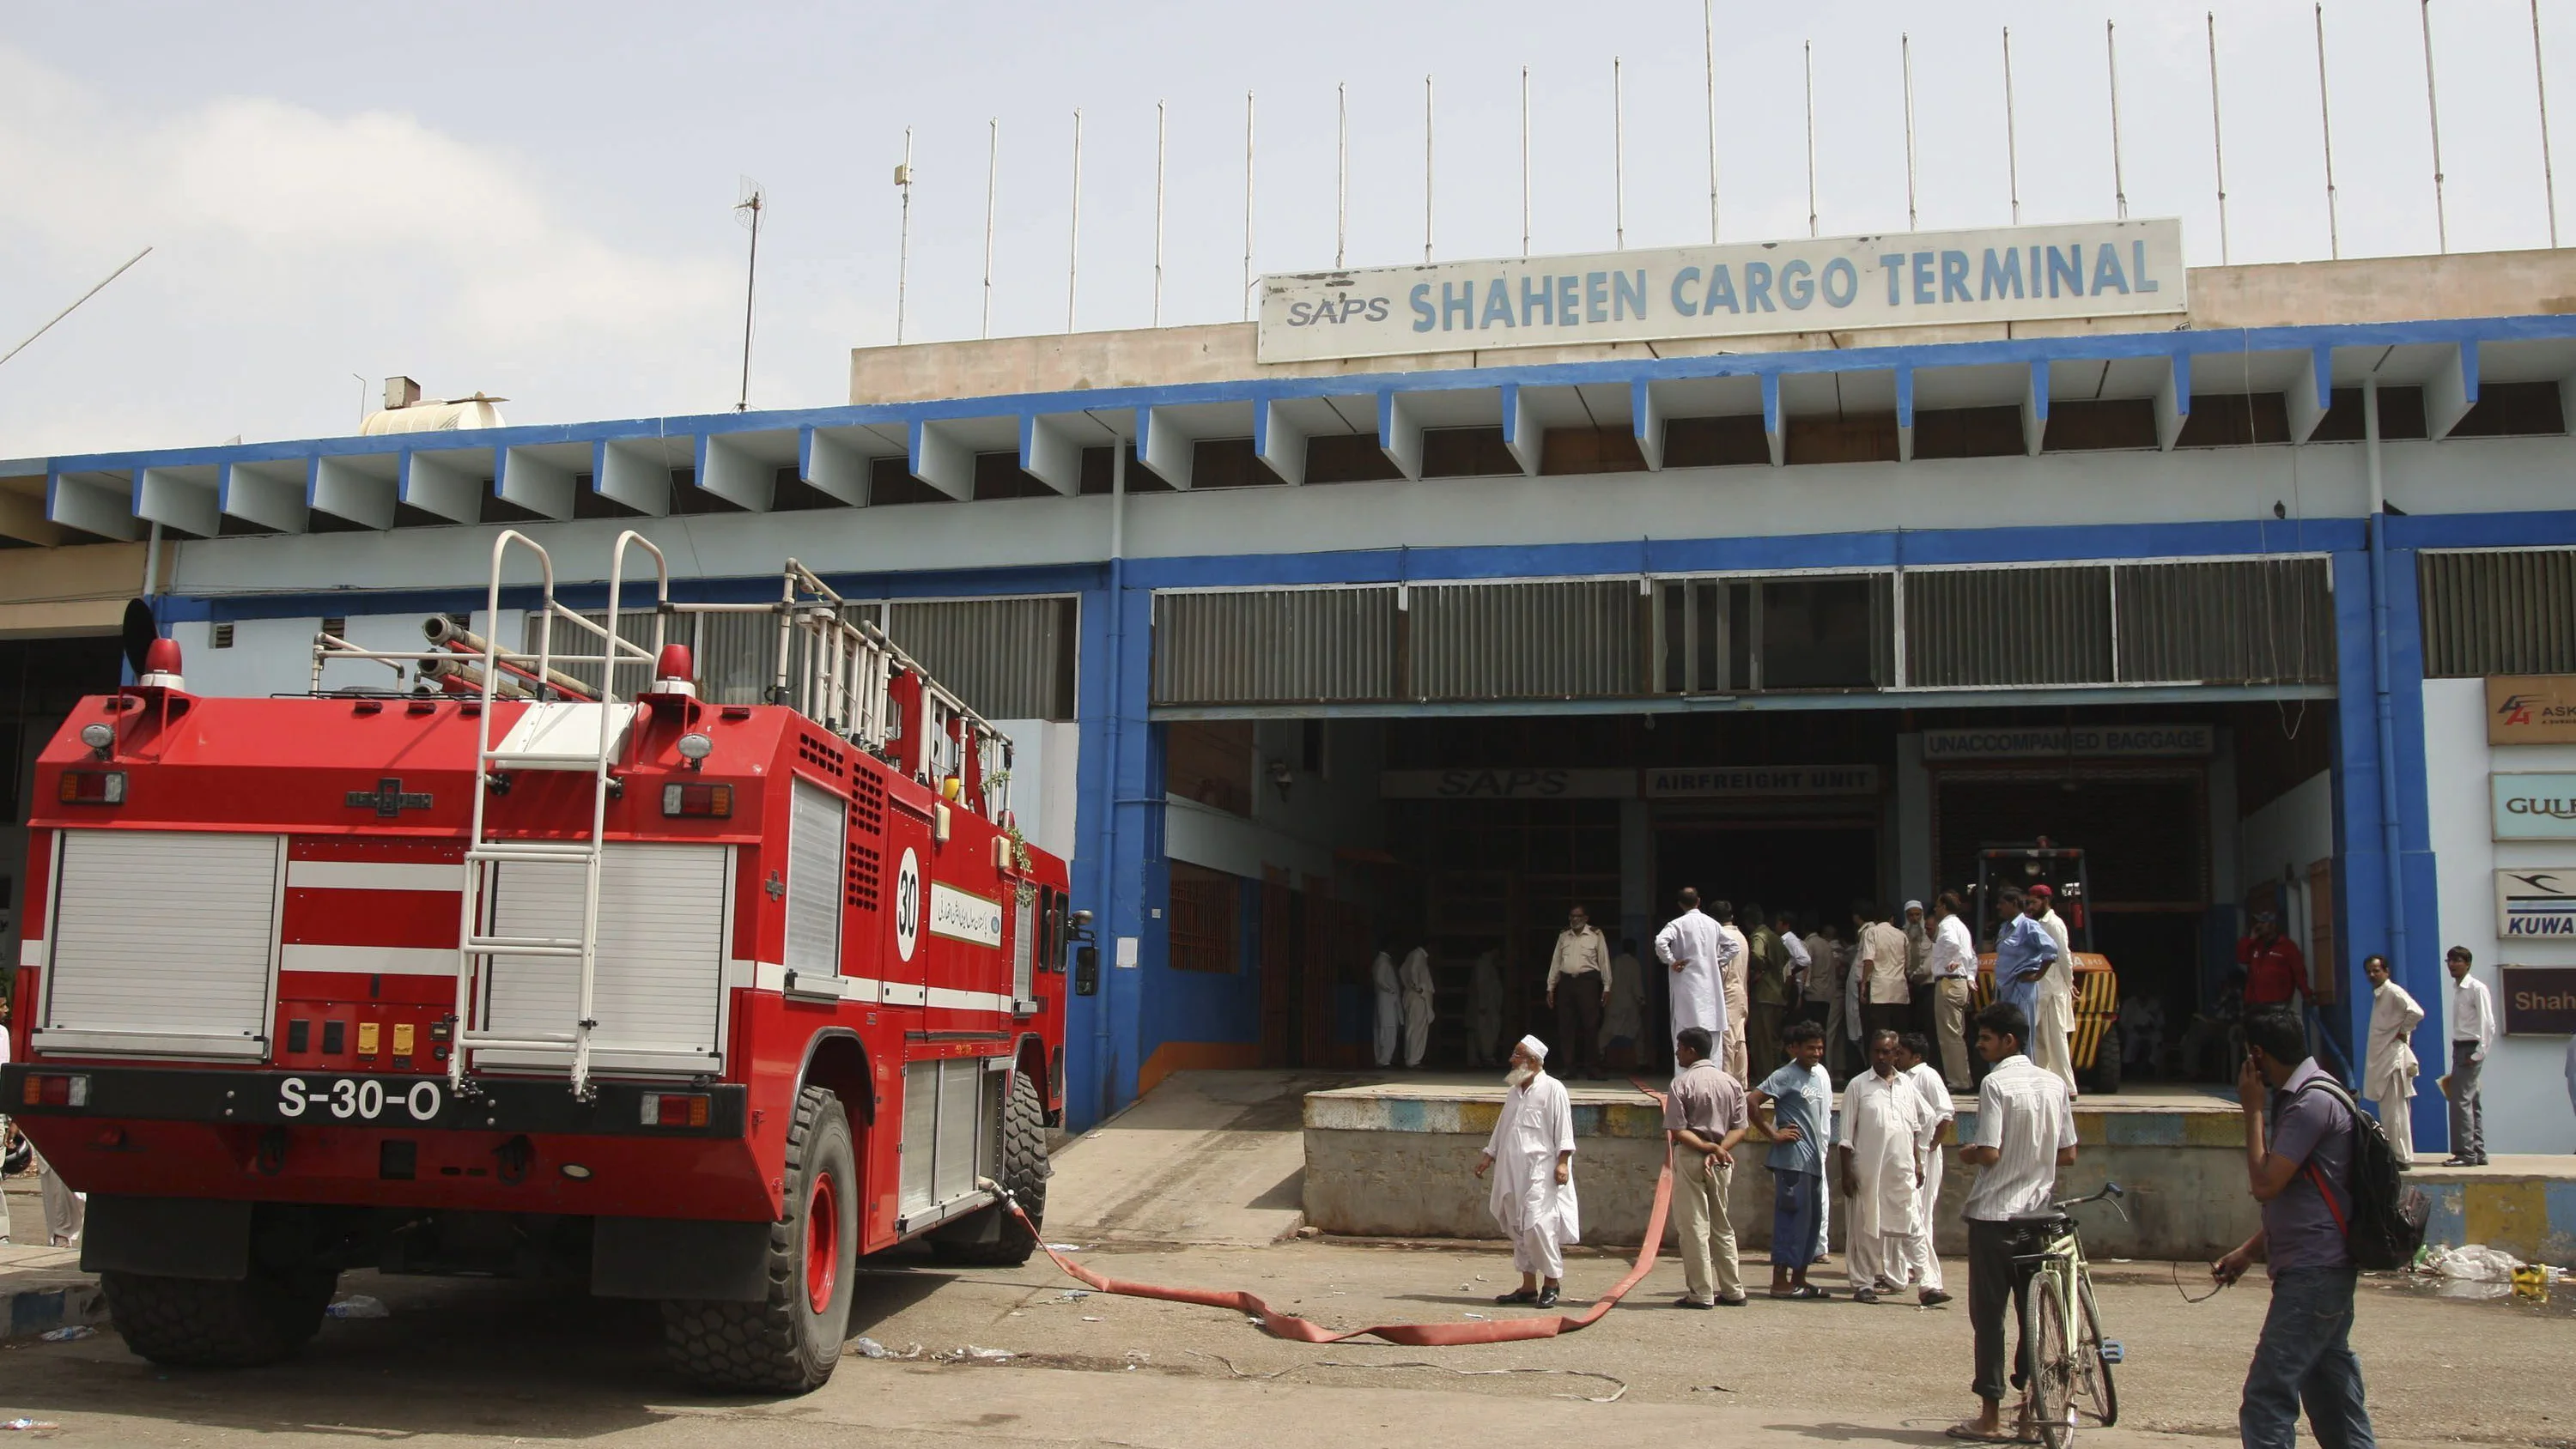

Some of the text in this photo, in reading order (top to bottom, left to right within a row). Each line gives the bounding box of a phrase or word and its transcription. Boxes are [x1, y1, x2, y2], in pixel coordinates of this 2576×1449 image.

[1286, 239, 2159, 333] SAPS SHAHEEN CARGO TERMINAL
[2106, 730, 2206, 750] BAGGAGE
[1437, 768, 1570, 796] SAPS
[1656, 771, 1868, 791] AIRFREIGHT UNIT
[899, 870, 916, 938] 30
[2515, 991, 2576, 1010] Shah
